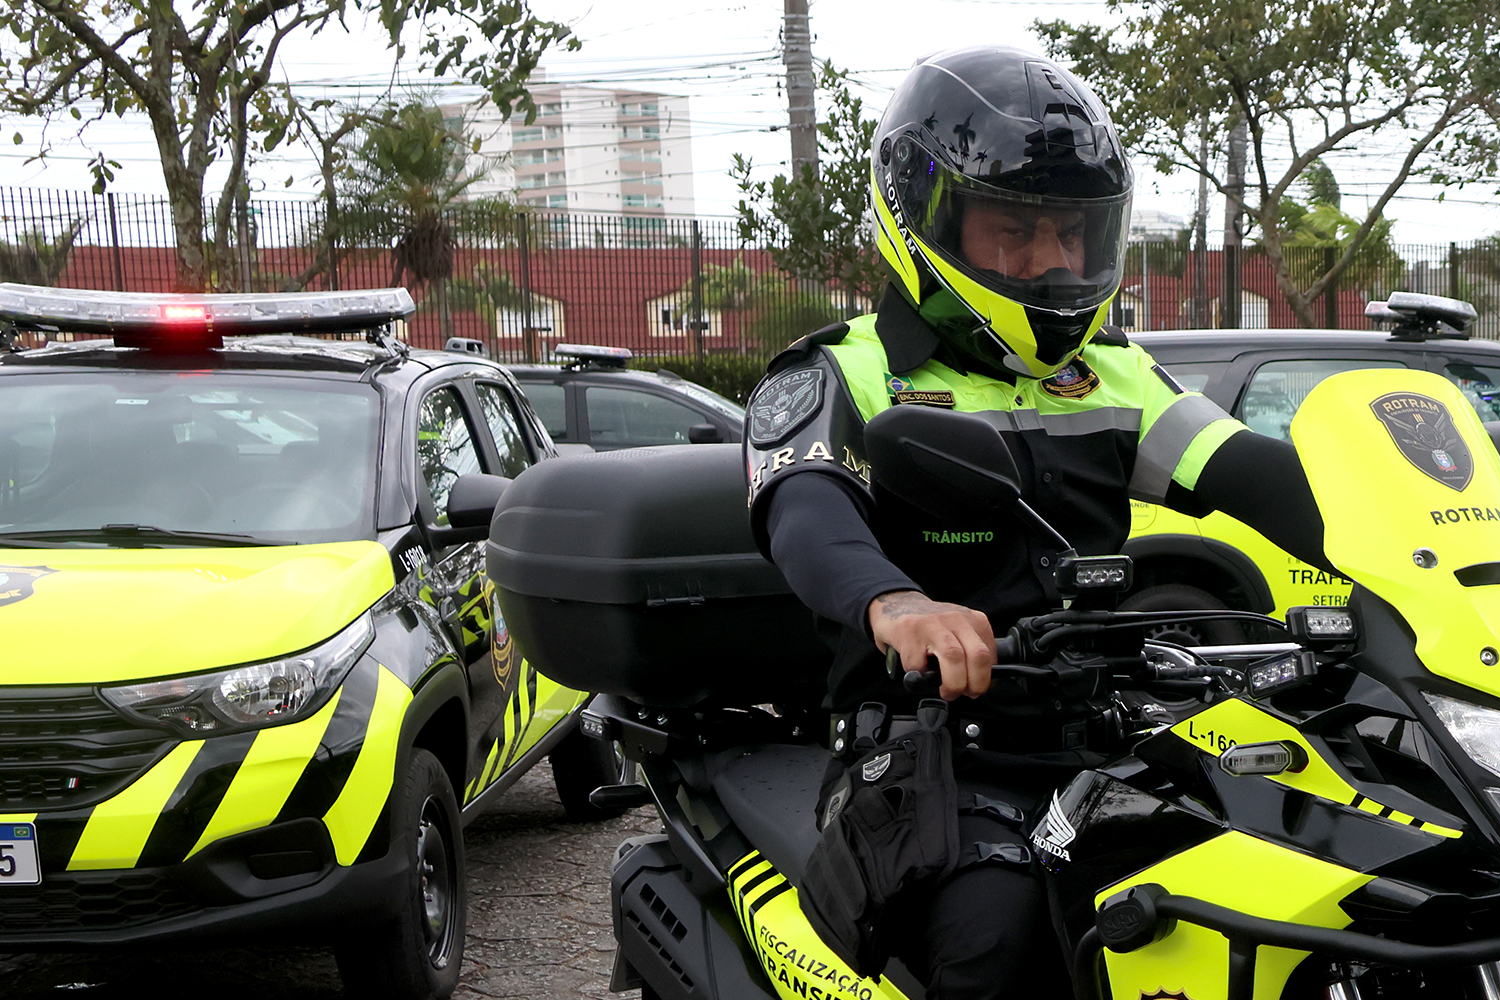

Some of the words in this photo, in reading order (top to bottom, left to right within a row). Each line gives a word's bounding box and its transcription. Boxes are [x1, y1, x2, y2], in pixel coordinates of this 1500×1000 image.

[885, 172, 916, 254] ROTRAM
[758, 371, 811, 404] ROTRAM
[1382, 398, 1440, 413] ROTRAM
[922, 529, 994, 544] TRÂNSITO
[1032, 834, 1071, 862] HONDA
